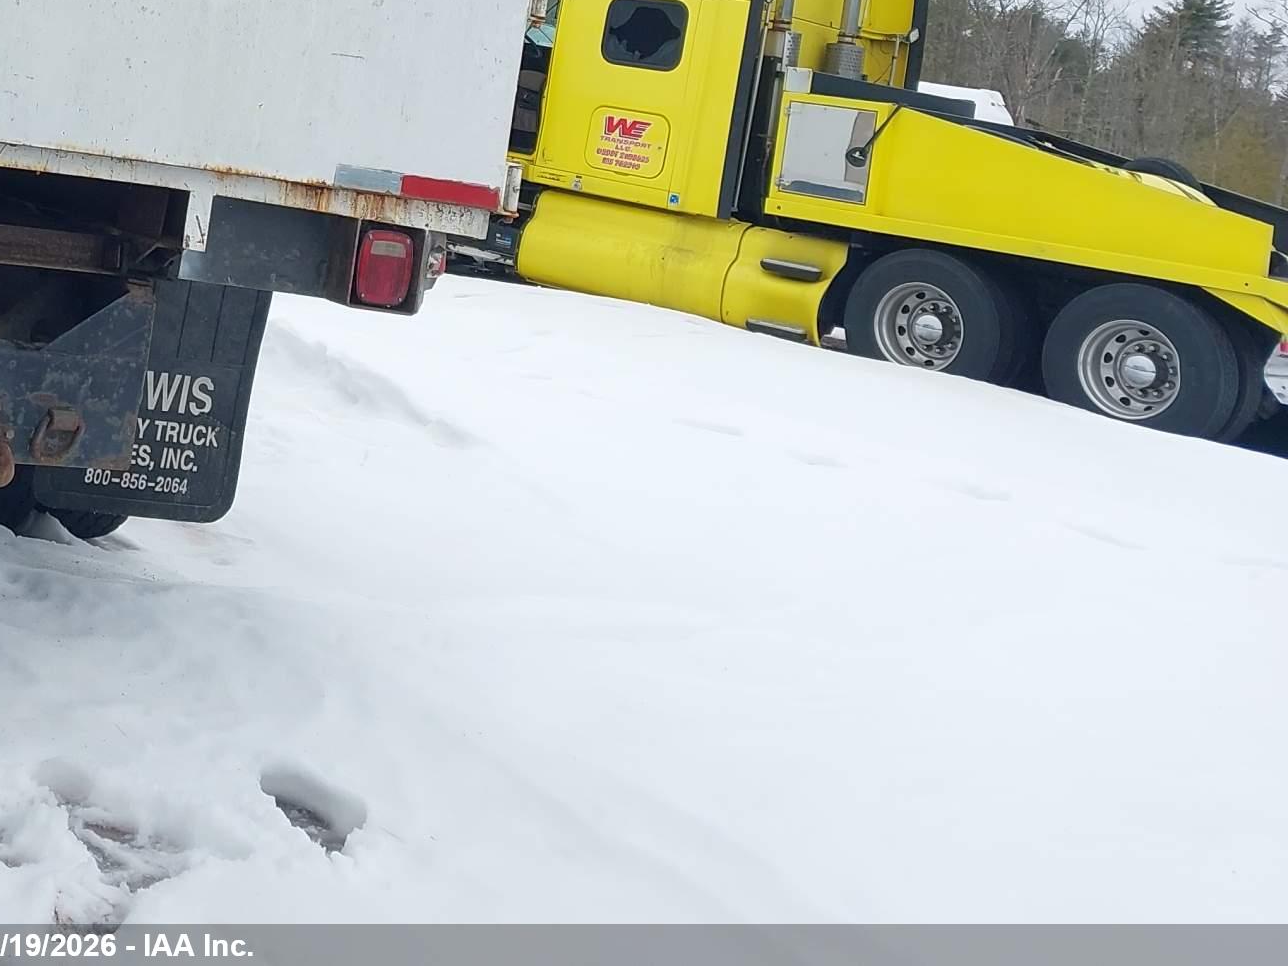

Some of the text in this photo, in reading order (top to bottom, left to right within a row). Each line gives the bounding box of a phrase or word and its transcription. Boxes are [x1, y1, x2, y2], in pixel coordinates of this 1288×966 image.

[604, 116, 652, 140] WE
[600, 135, 652, 149] TRANSPORT
[146, 370, 215, 416] WIS
[154, 420, 220, 448] TRUCK
[160, 447, 198, 472] INC.
[84, 468, 188, 494] 800-856-2064
